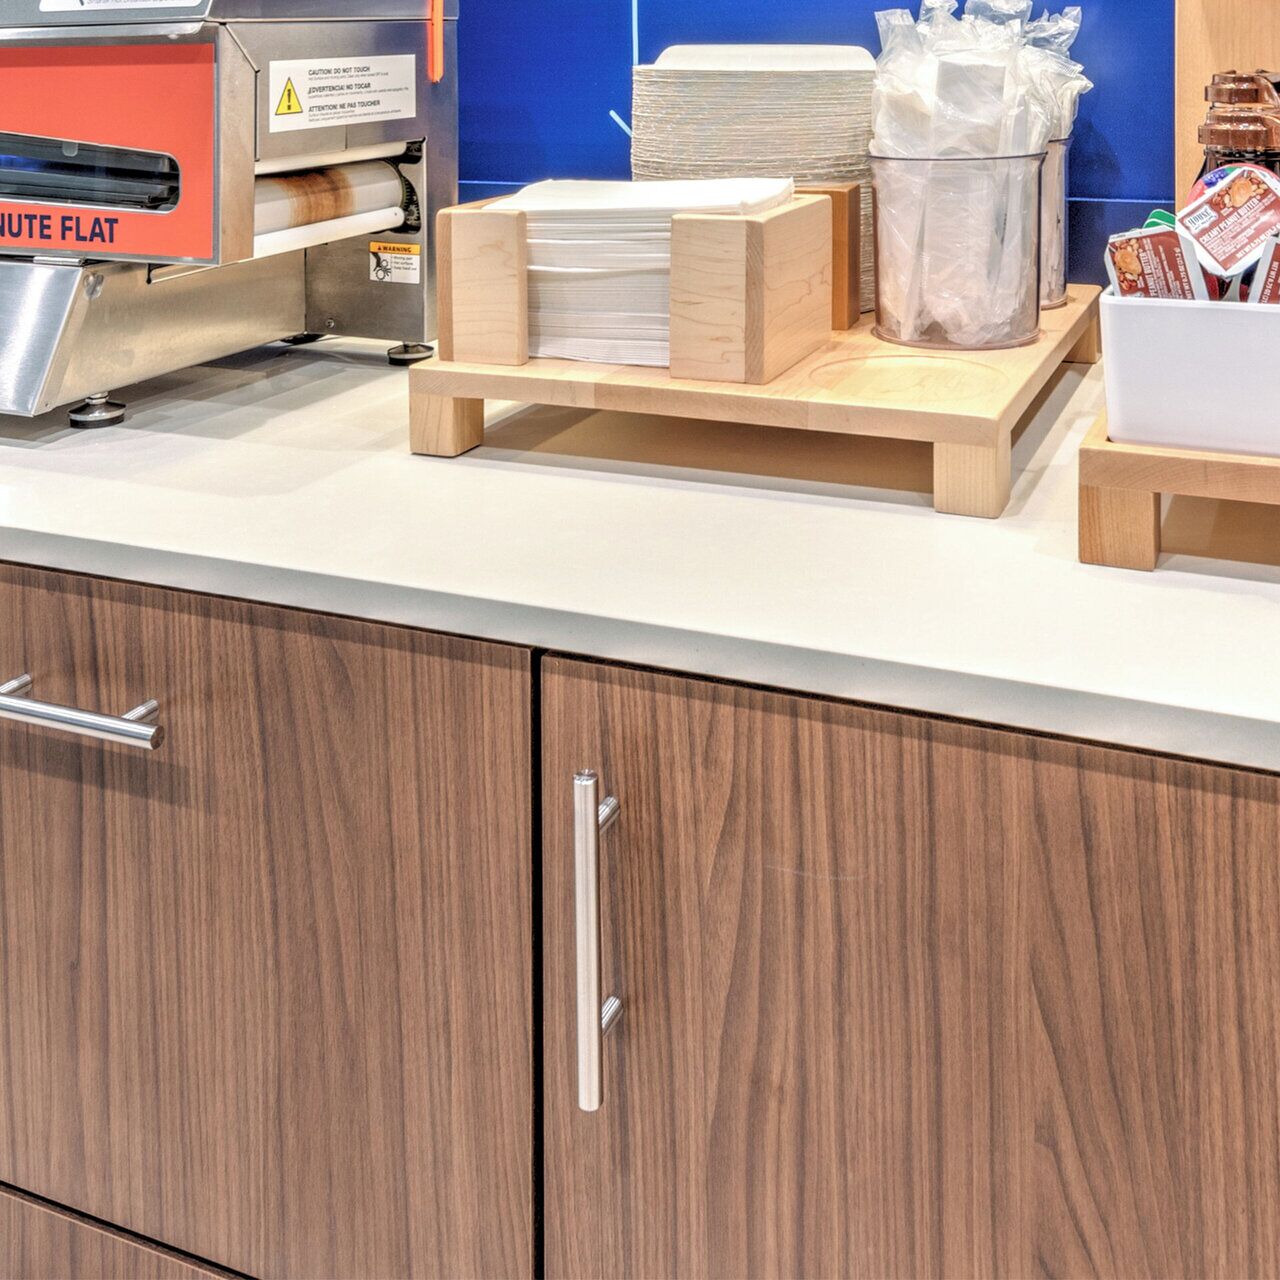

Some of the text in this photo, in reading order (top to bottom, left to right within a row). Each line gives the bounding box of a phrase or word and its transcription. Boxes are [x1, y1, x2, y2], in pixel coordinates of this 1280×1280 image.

[60, 216, 119, 243] FLAT
[1187, 206, 1212, 228] HOUSE
[1198, 224, 1222, 245] CREAMY
[1218, 211, 1240, 230] PEANUT
